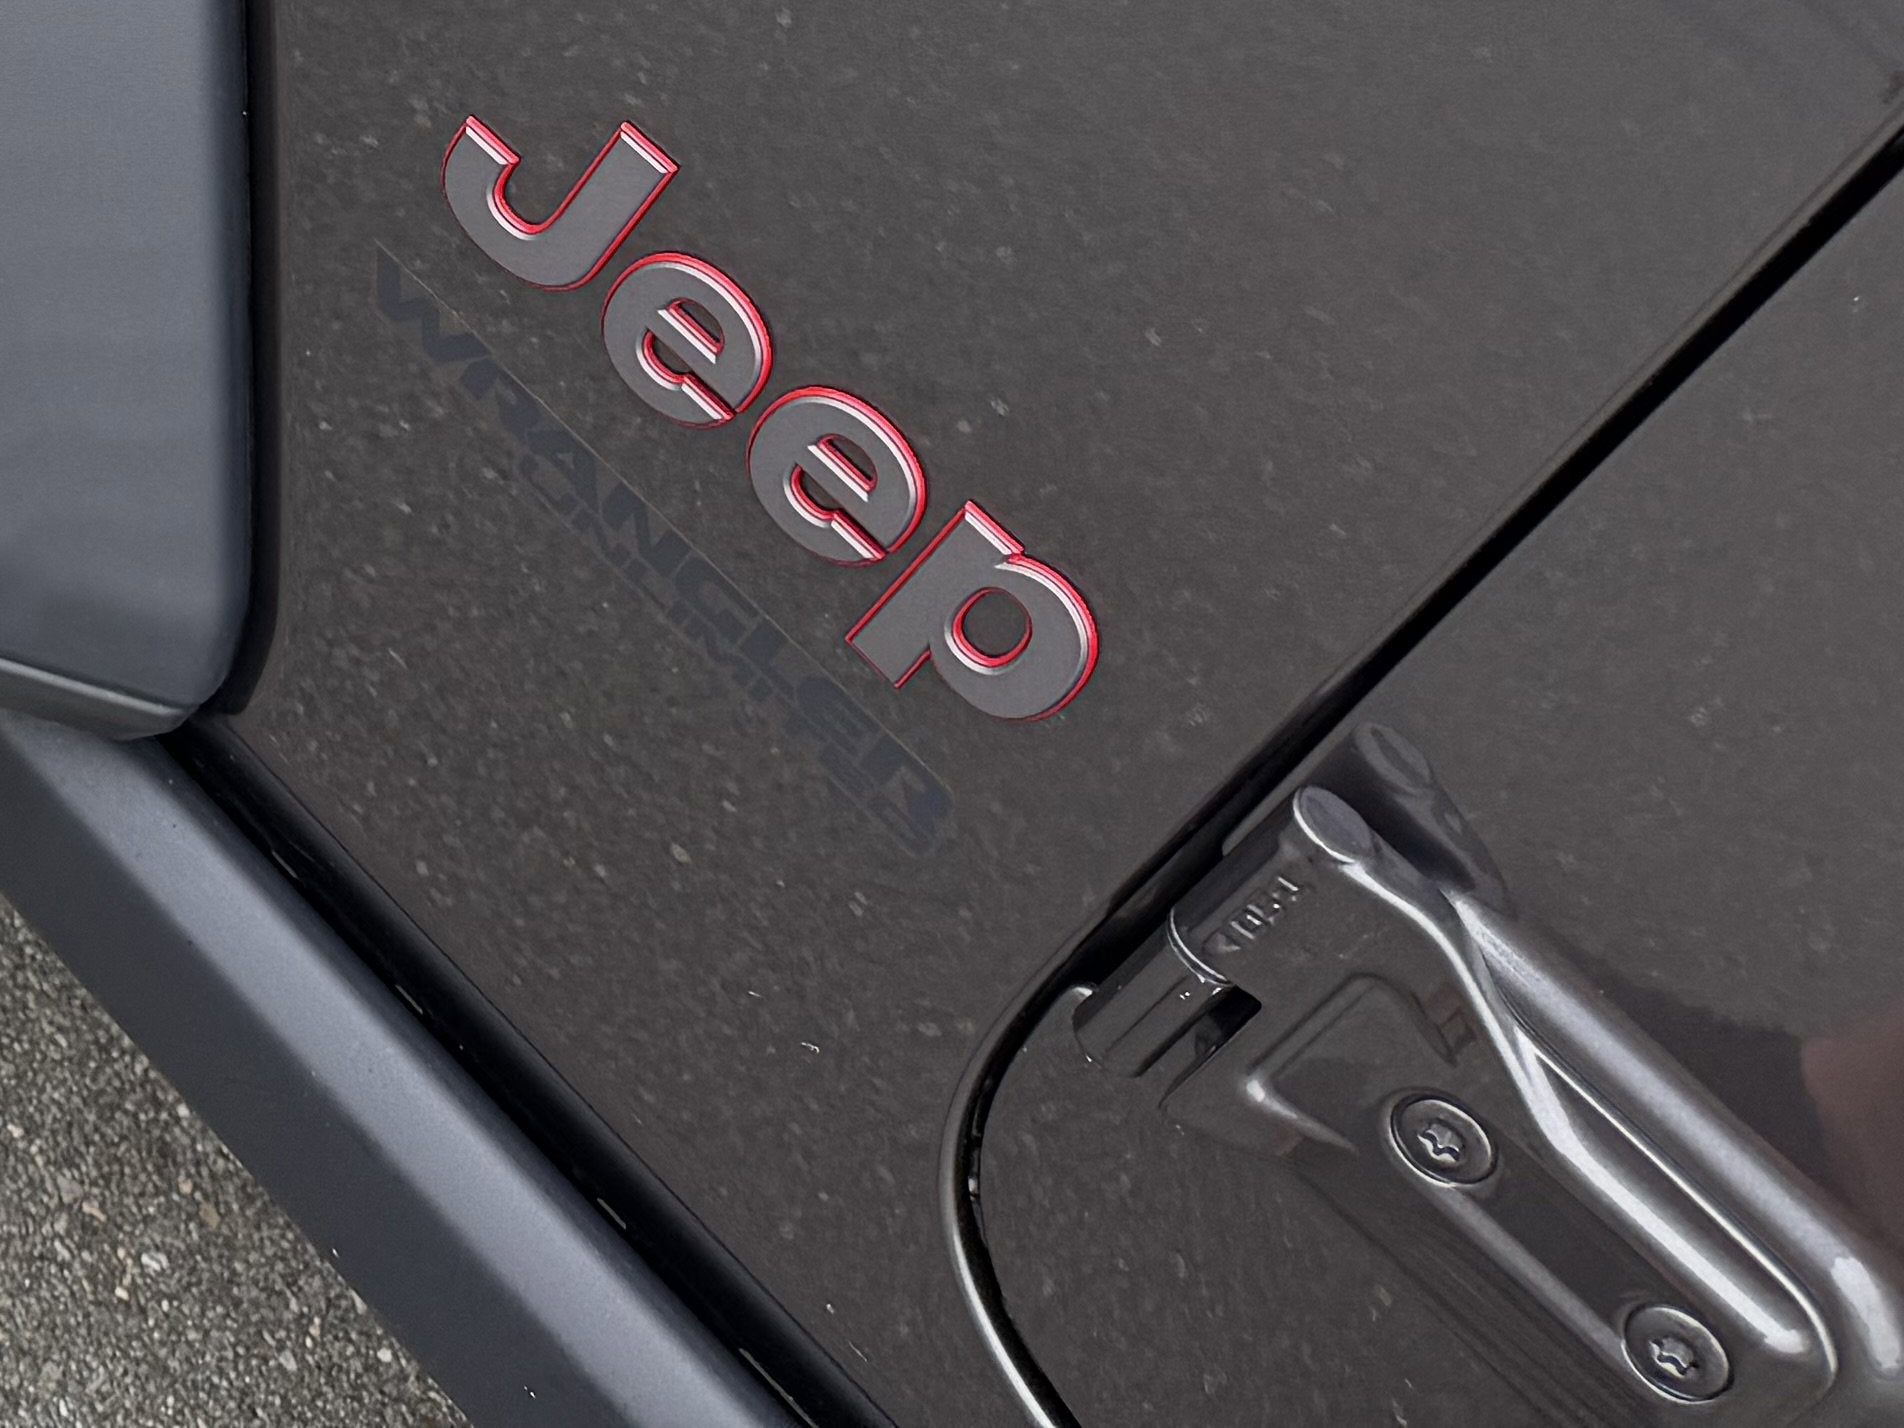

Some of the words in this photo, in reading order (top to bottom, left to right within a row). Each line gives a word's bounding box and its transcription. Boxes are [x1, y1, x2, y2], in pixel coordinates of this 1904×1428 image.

[376, 244, 956, 836] WRANGLER
[439, 114, 1100, 722] Jeep
[517, 449, 935, 857] UNLIMITED
